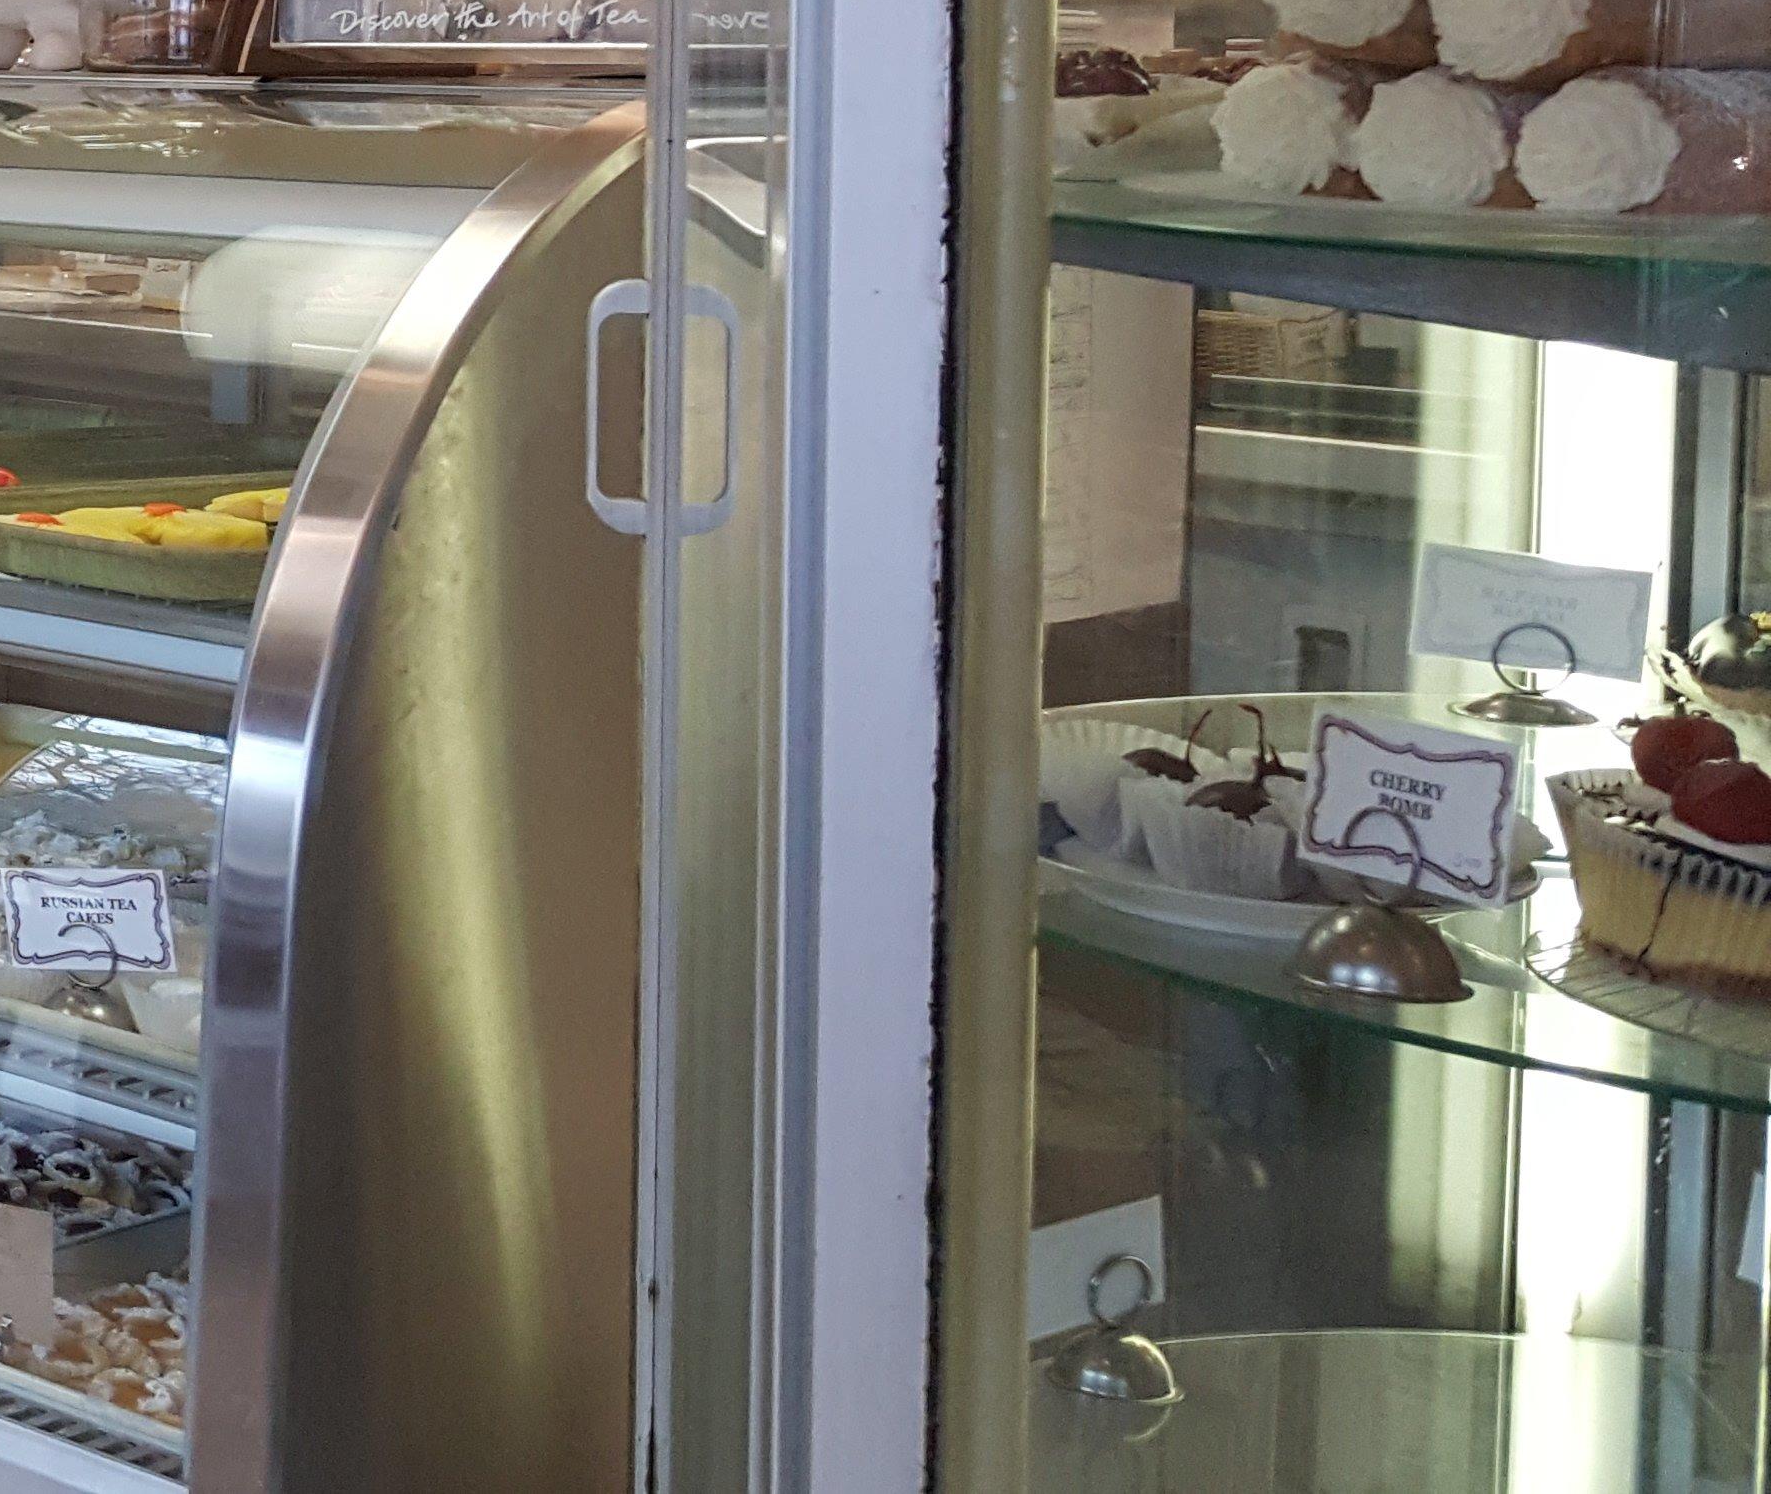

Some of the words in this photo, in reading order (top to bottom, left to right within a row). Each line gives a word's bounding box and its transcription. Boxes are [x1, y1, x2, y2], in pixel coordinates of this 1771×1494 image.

[331, 7, 444, 31] Discover
[454, 2, 499, 29] the
[508, 2, 553, 29] Art
[557, 1, 585, 34] of
[591, 0, 651, 26] Tea
[1370, 770, 1446, 801] CHERRY
[41, 896, 104, 910] RUSSIAN
[107, 898, 137, 911] TEA
[66, 911, 114, 925] CAKES
